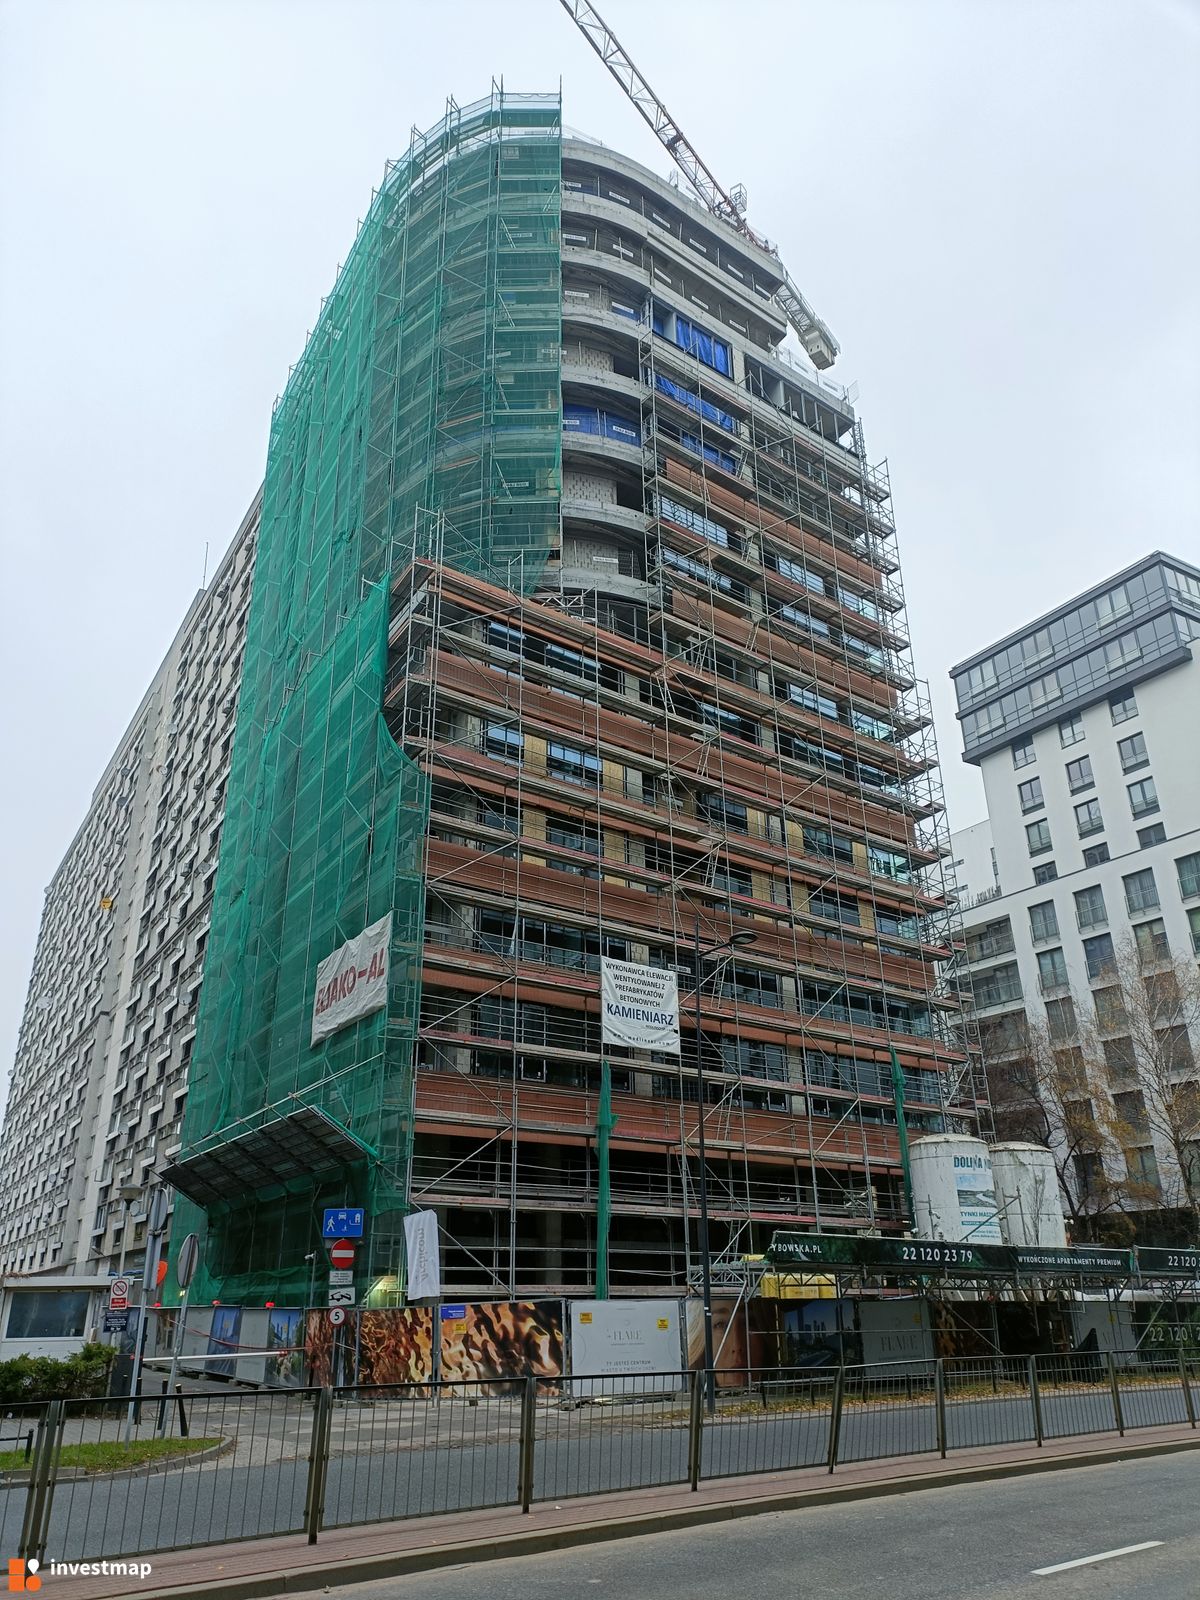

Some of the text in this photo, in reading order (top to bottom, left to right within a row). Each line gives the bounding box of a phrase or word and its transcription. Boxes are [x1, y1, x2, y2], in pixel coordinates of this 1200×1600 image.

[605, 962, 674, 982] WYKONAWCA ELEWACJI
[613, 974, 661, 988] WENTYLOWANEJ
[615, 984, 664, 999] PREFABRYKATÓW
[620, 994, 661, 1008] BETONOWYCH
[607, 1003, 674, 1026] KAMIENIARZ
[953, 1155, 983, 1170] DOLINA
[902, 1247, 973, 1263] 22 120 23 79
[1018, 1254, 1121, 1266] WYKOŃCZONE APARTAMENTY PREMIUM
[1168, 1255, 1179, 1266] 22
[1181, 1256, 1197, 1267] 120
[334, 1311, 340, 1321] 5
[1149, 1327, 1165, 1342] 22
[1168, 1327, 1188, 1341] 120
